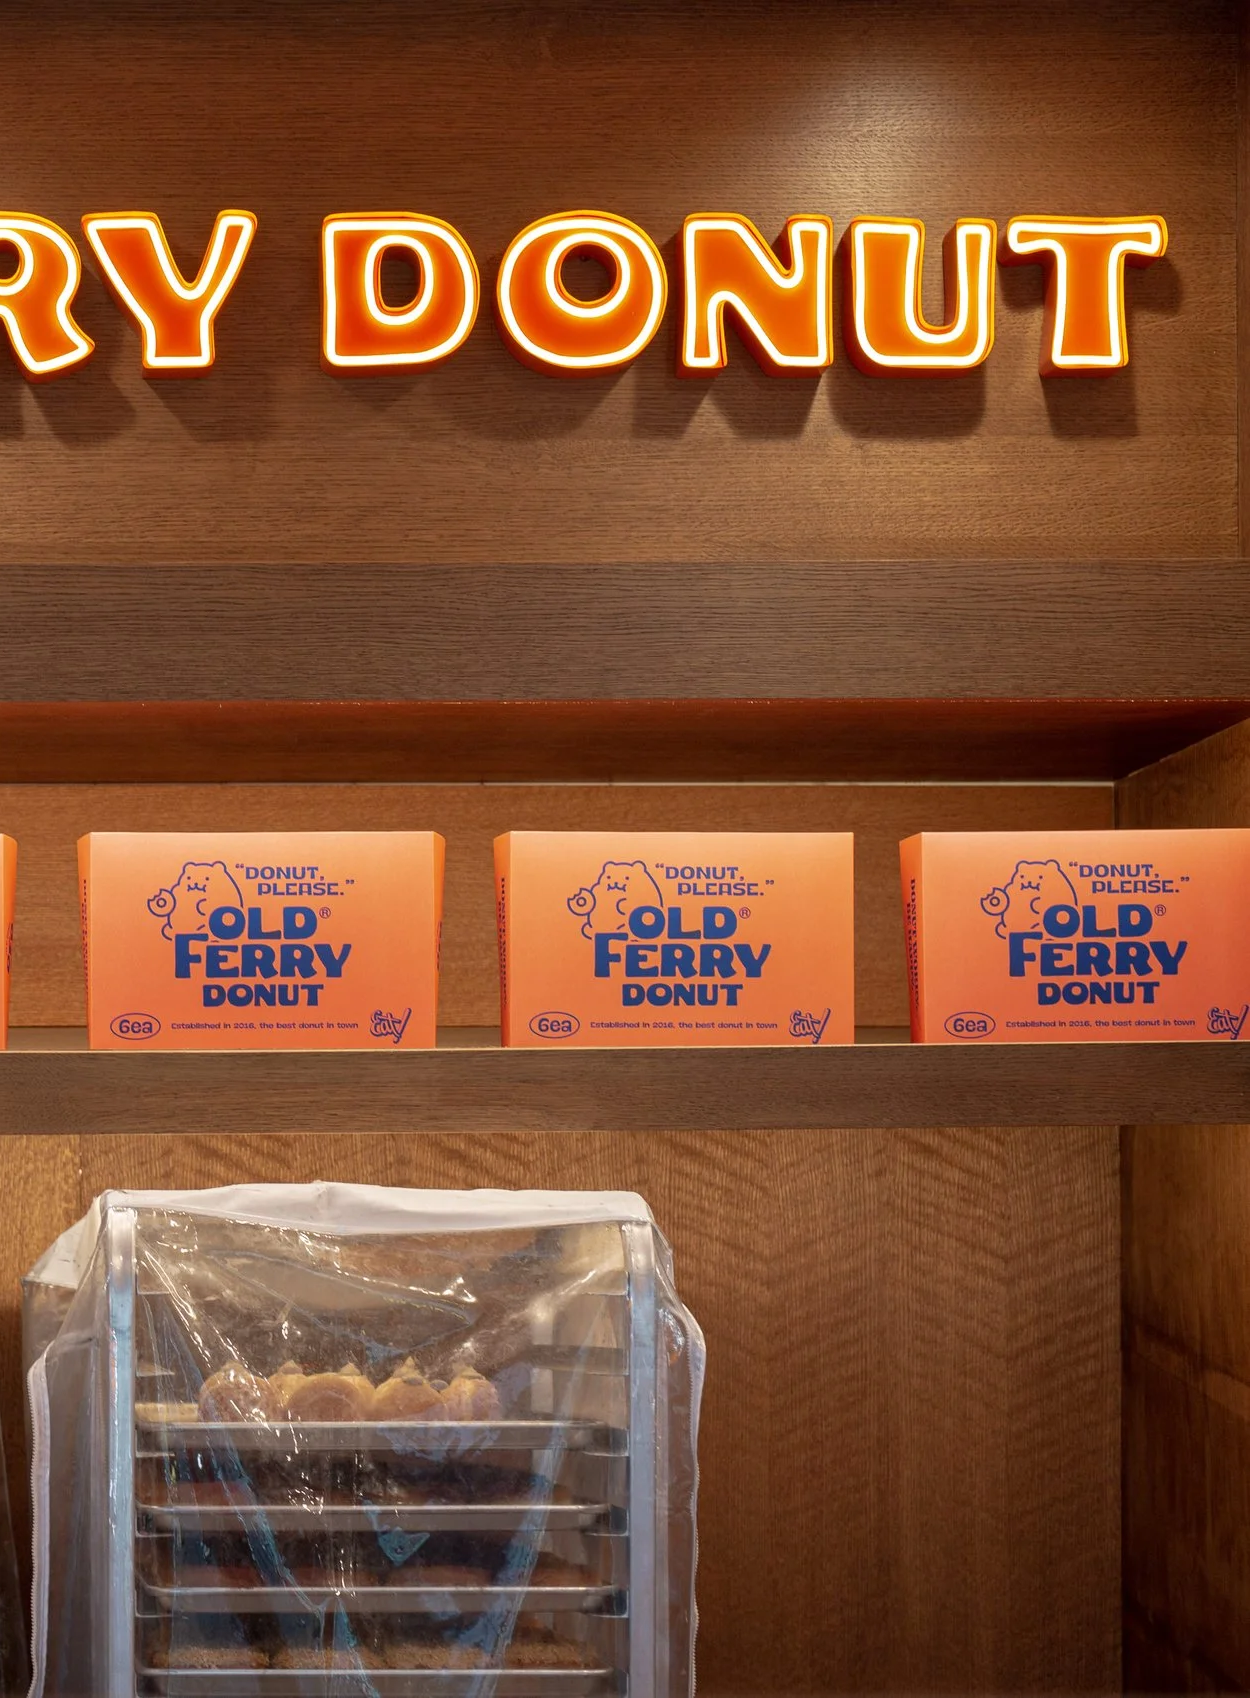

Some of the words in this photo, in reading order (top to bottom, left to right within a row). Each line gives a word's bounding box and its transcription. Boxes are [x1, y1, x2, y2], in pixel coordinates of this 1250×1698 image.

[321, 209, 1168, 378] DONUT
[174, 932, 352, 979] FERRY
[594, 932, 771, 978] FERRY
[1008, 929, 1188, 977] FERRY
[203, 984, 323, 1007] DONUT
[622, 983, 742, 1006] DONUT
[1037, 981, 1159, 1005] DONUT
[120, 1018, 153, 1033] 6ea
[539, 1018, 572, 1032] 6ea
[953, 1017, 988, 1032] 6ea
[1006, 1020, 1056, 1028] Established
[1135, 1019, 1160, 1027] donut
